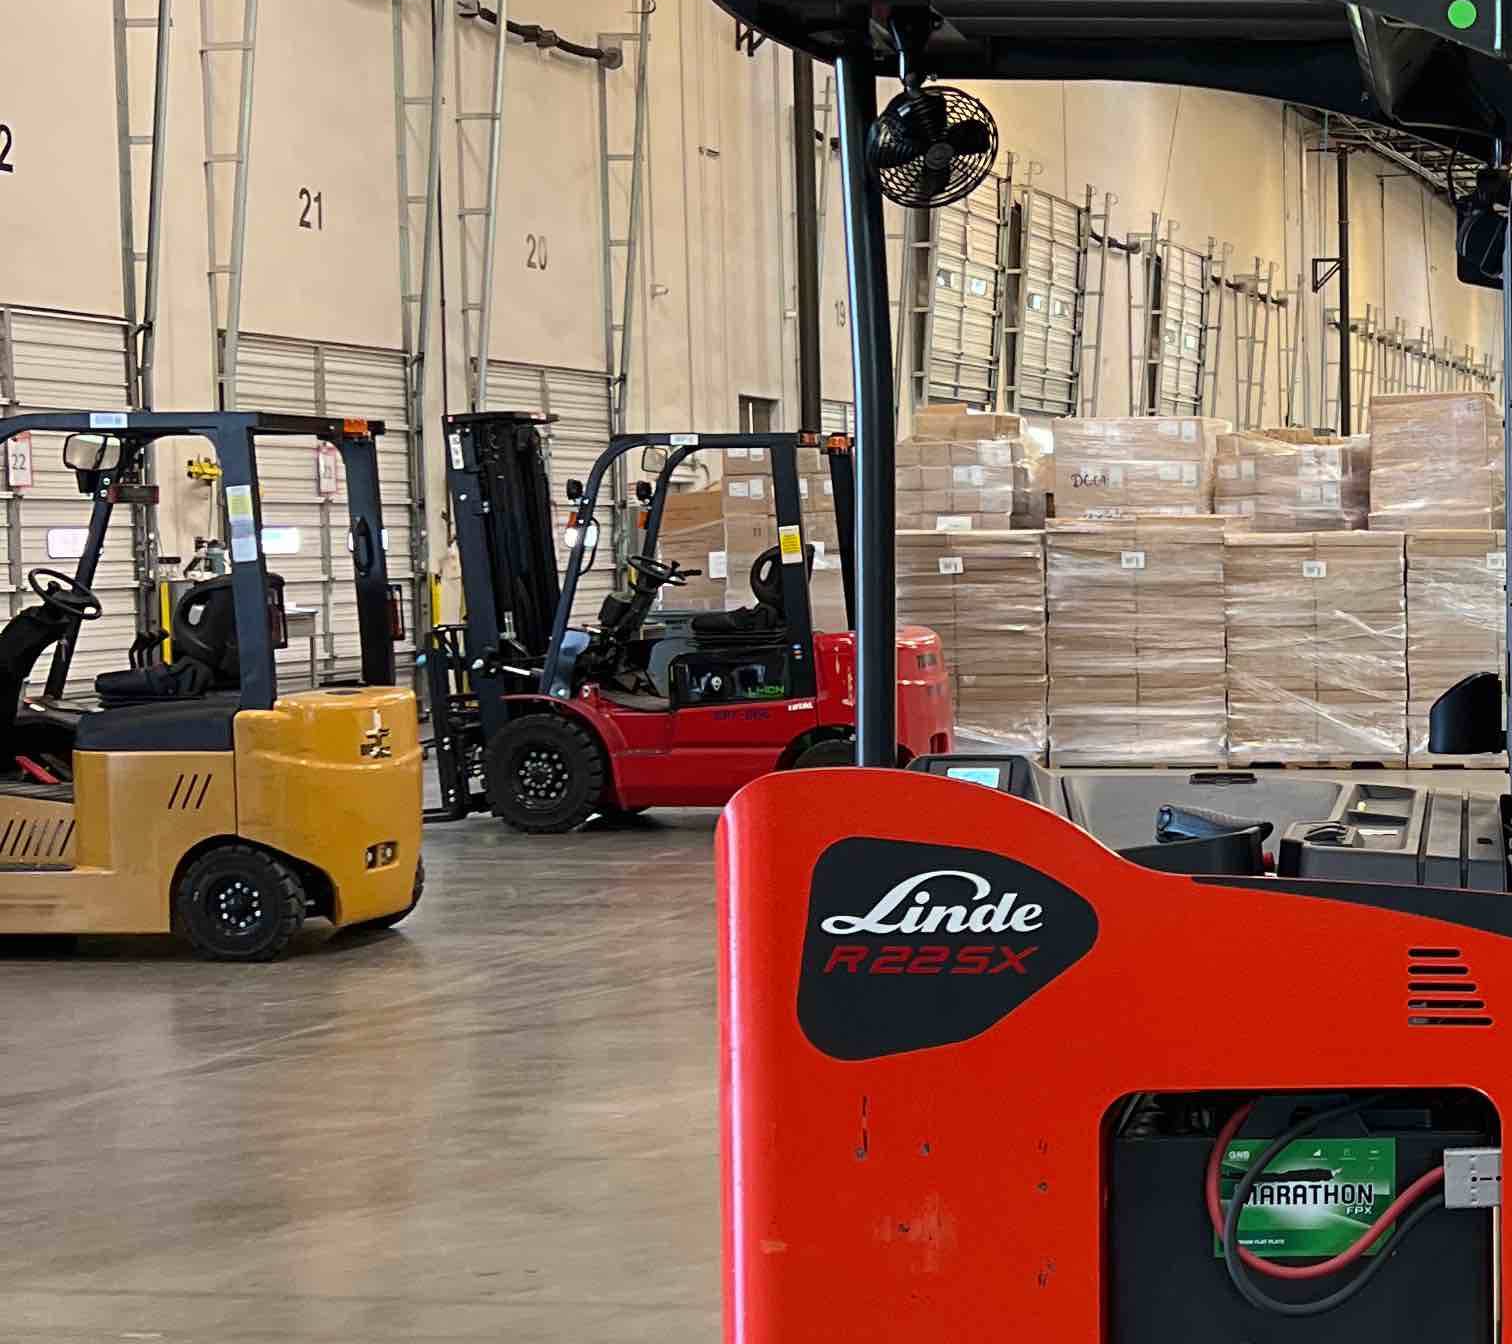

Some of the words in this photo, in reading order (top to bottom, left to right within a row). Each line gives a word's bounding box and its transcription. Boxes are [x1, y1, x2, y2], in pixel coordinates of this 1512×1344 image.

[298, 187, 323, 231] 21
[525, 233, 547, 271] 20
[11, 454, 27, 470] 22
[821, 870, 1044, 935] Linde
[1346, 1207, 1373, 1215] FPX
